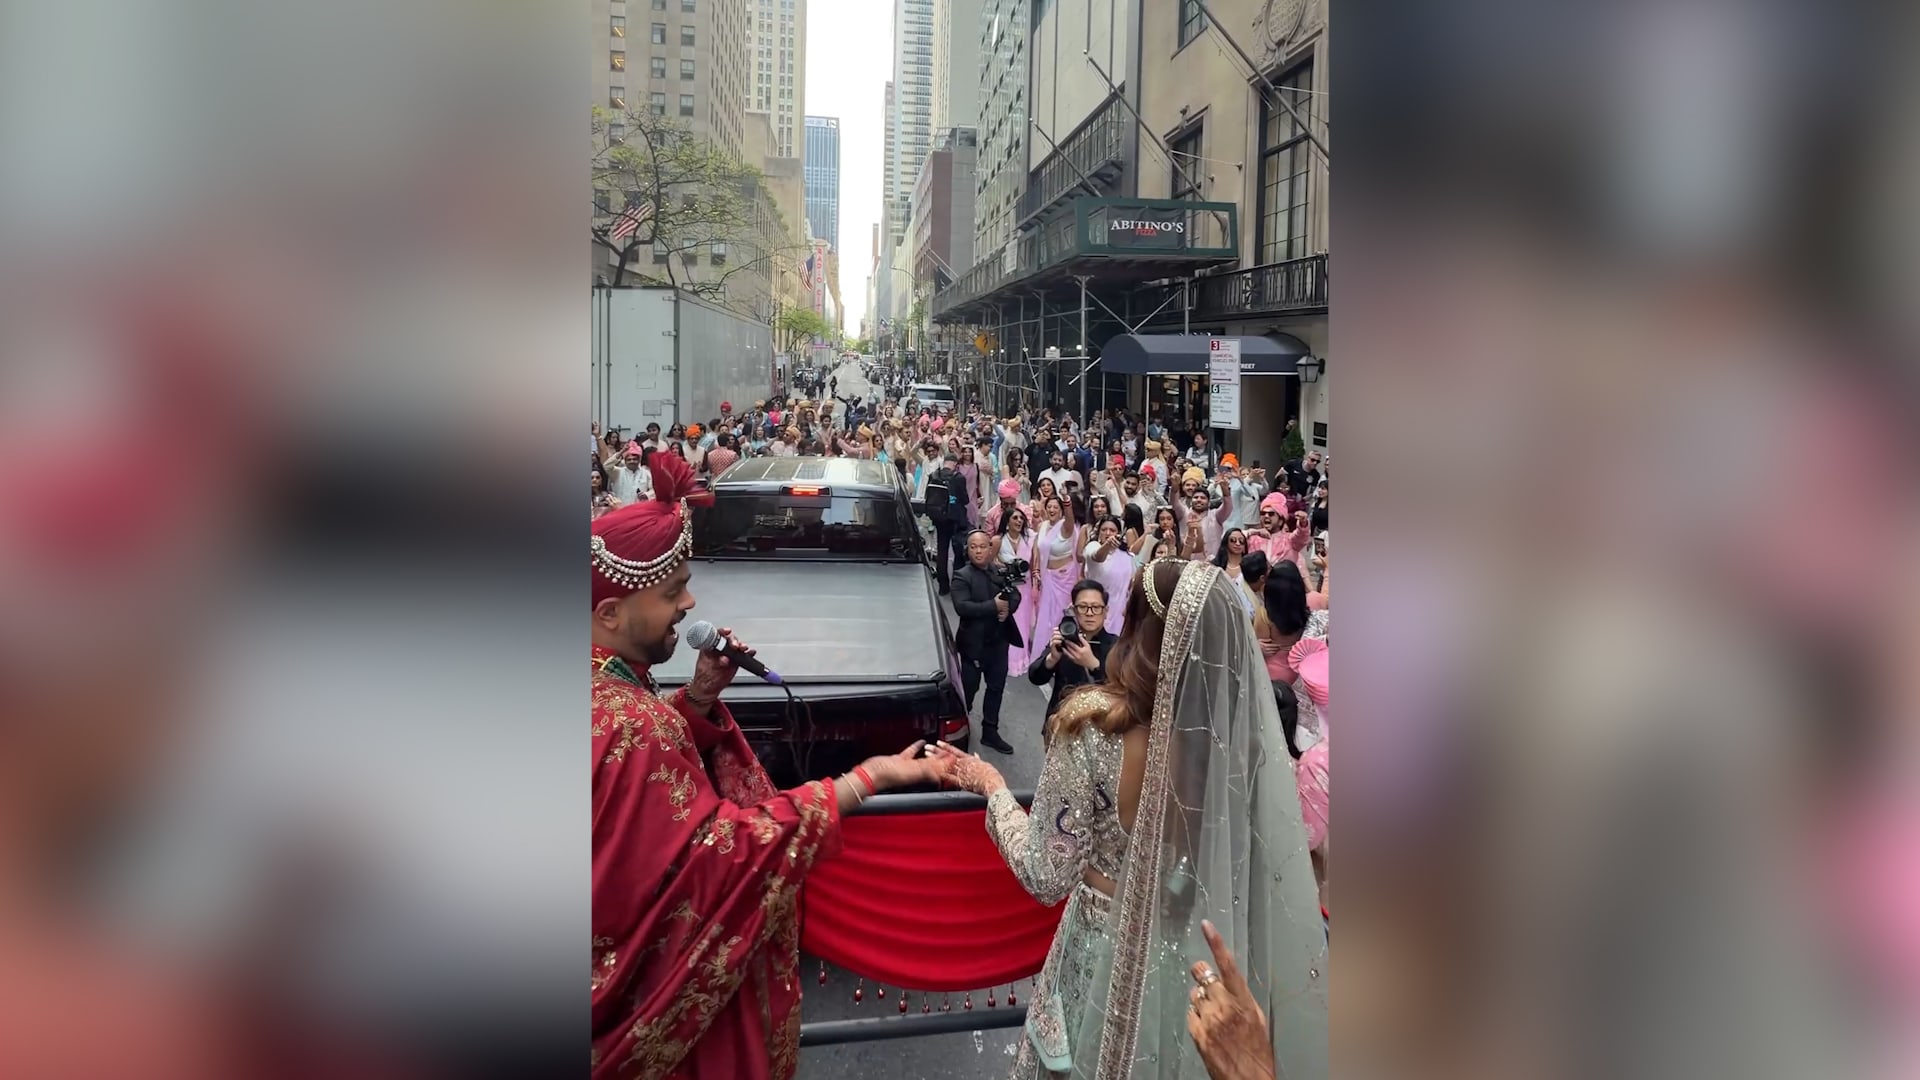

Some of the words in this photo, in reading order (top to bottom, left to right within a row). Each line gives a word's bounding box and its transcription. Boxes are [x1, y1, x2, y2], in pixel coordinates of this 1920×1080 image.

[1111, 220, 1184, 233] ABITINO'S
[1212, 341, 1218, 350] 3
[1212, 384, 1218, 393] 6
